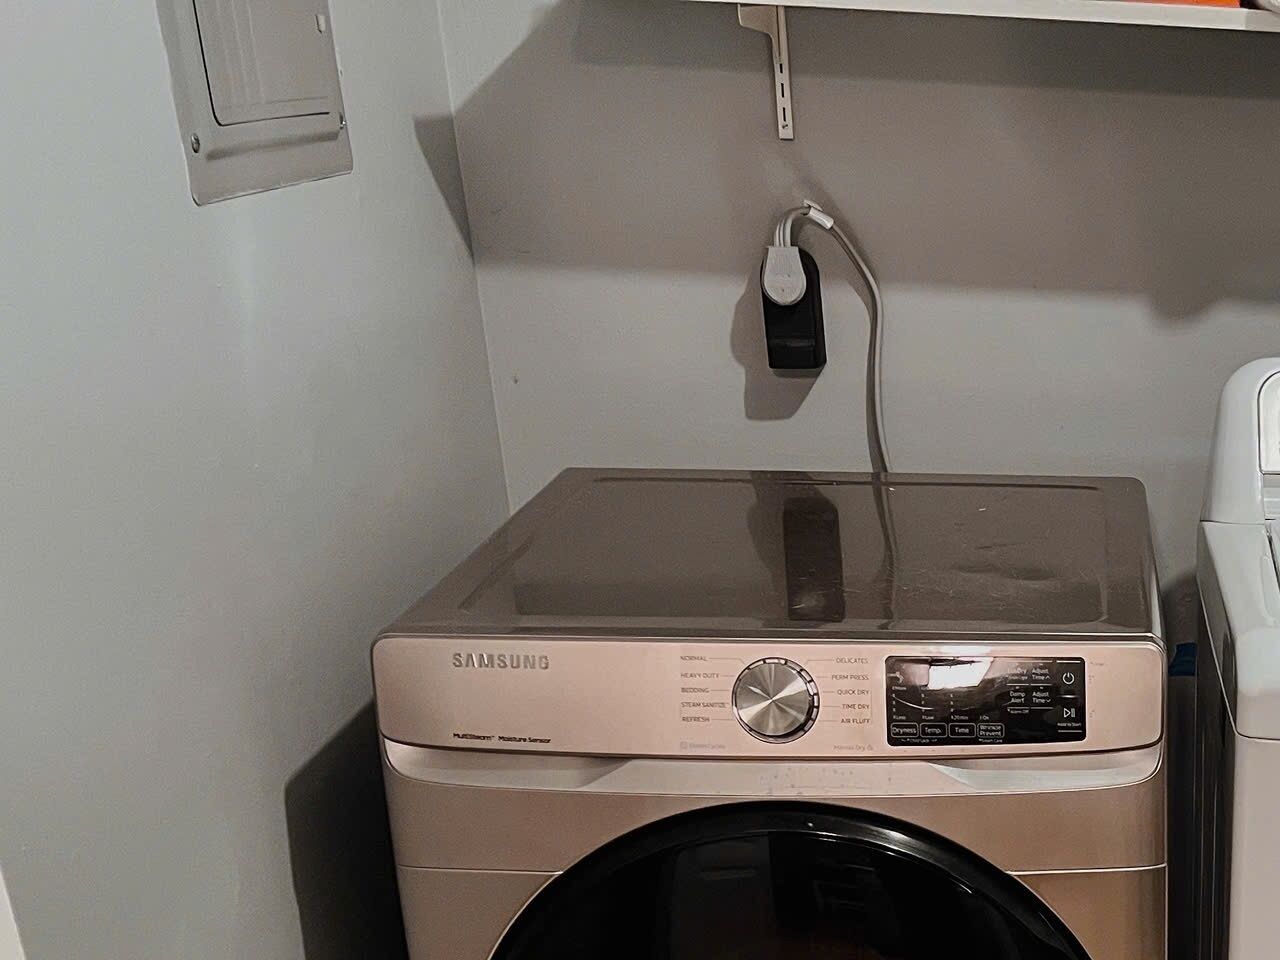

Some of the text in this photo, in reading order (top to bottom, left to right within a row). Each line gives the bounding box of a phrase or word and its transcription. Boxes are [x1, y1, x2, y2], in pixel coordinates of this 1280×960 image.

[452, 652, 550, 671] SAMSUNG
[891, 726, 917, 735] Dryness
[955, 726, 969, 734] Time
